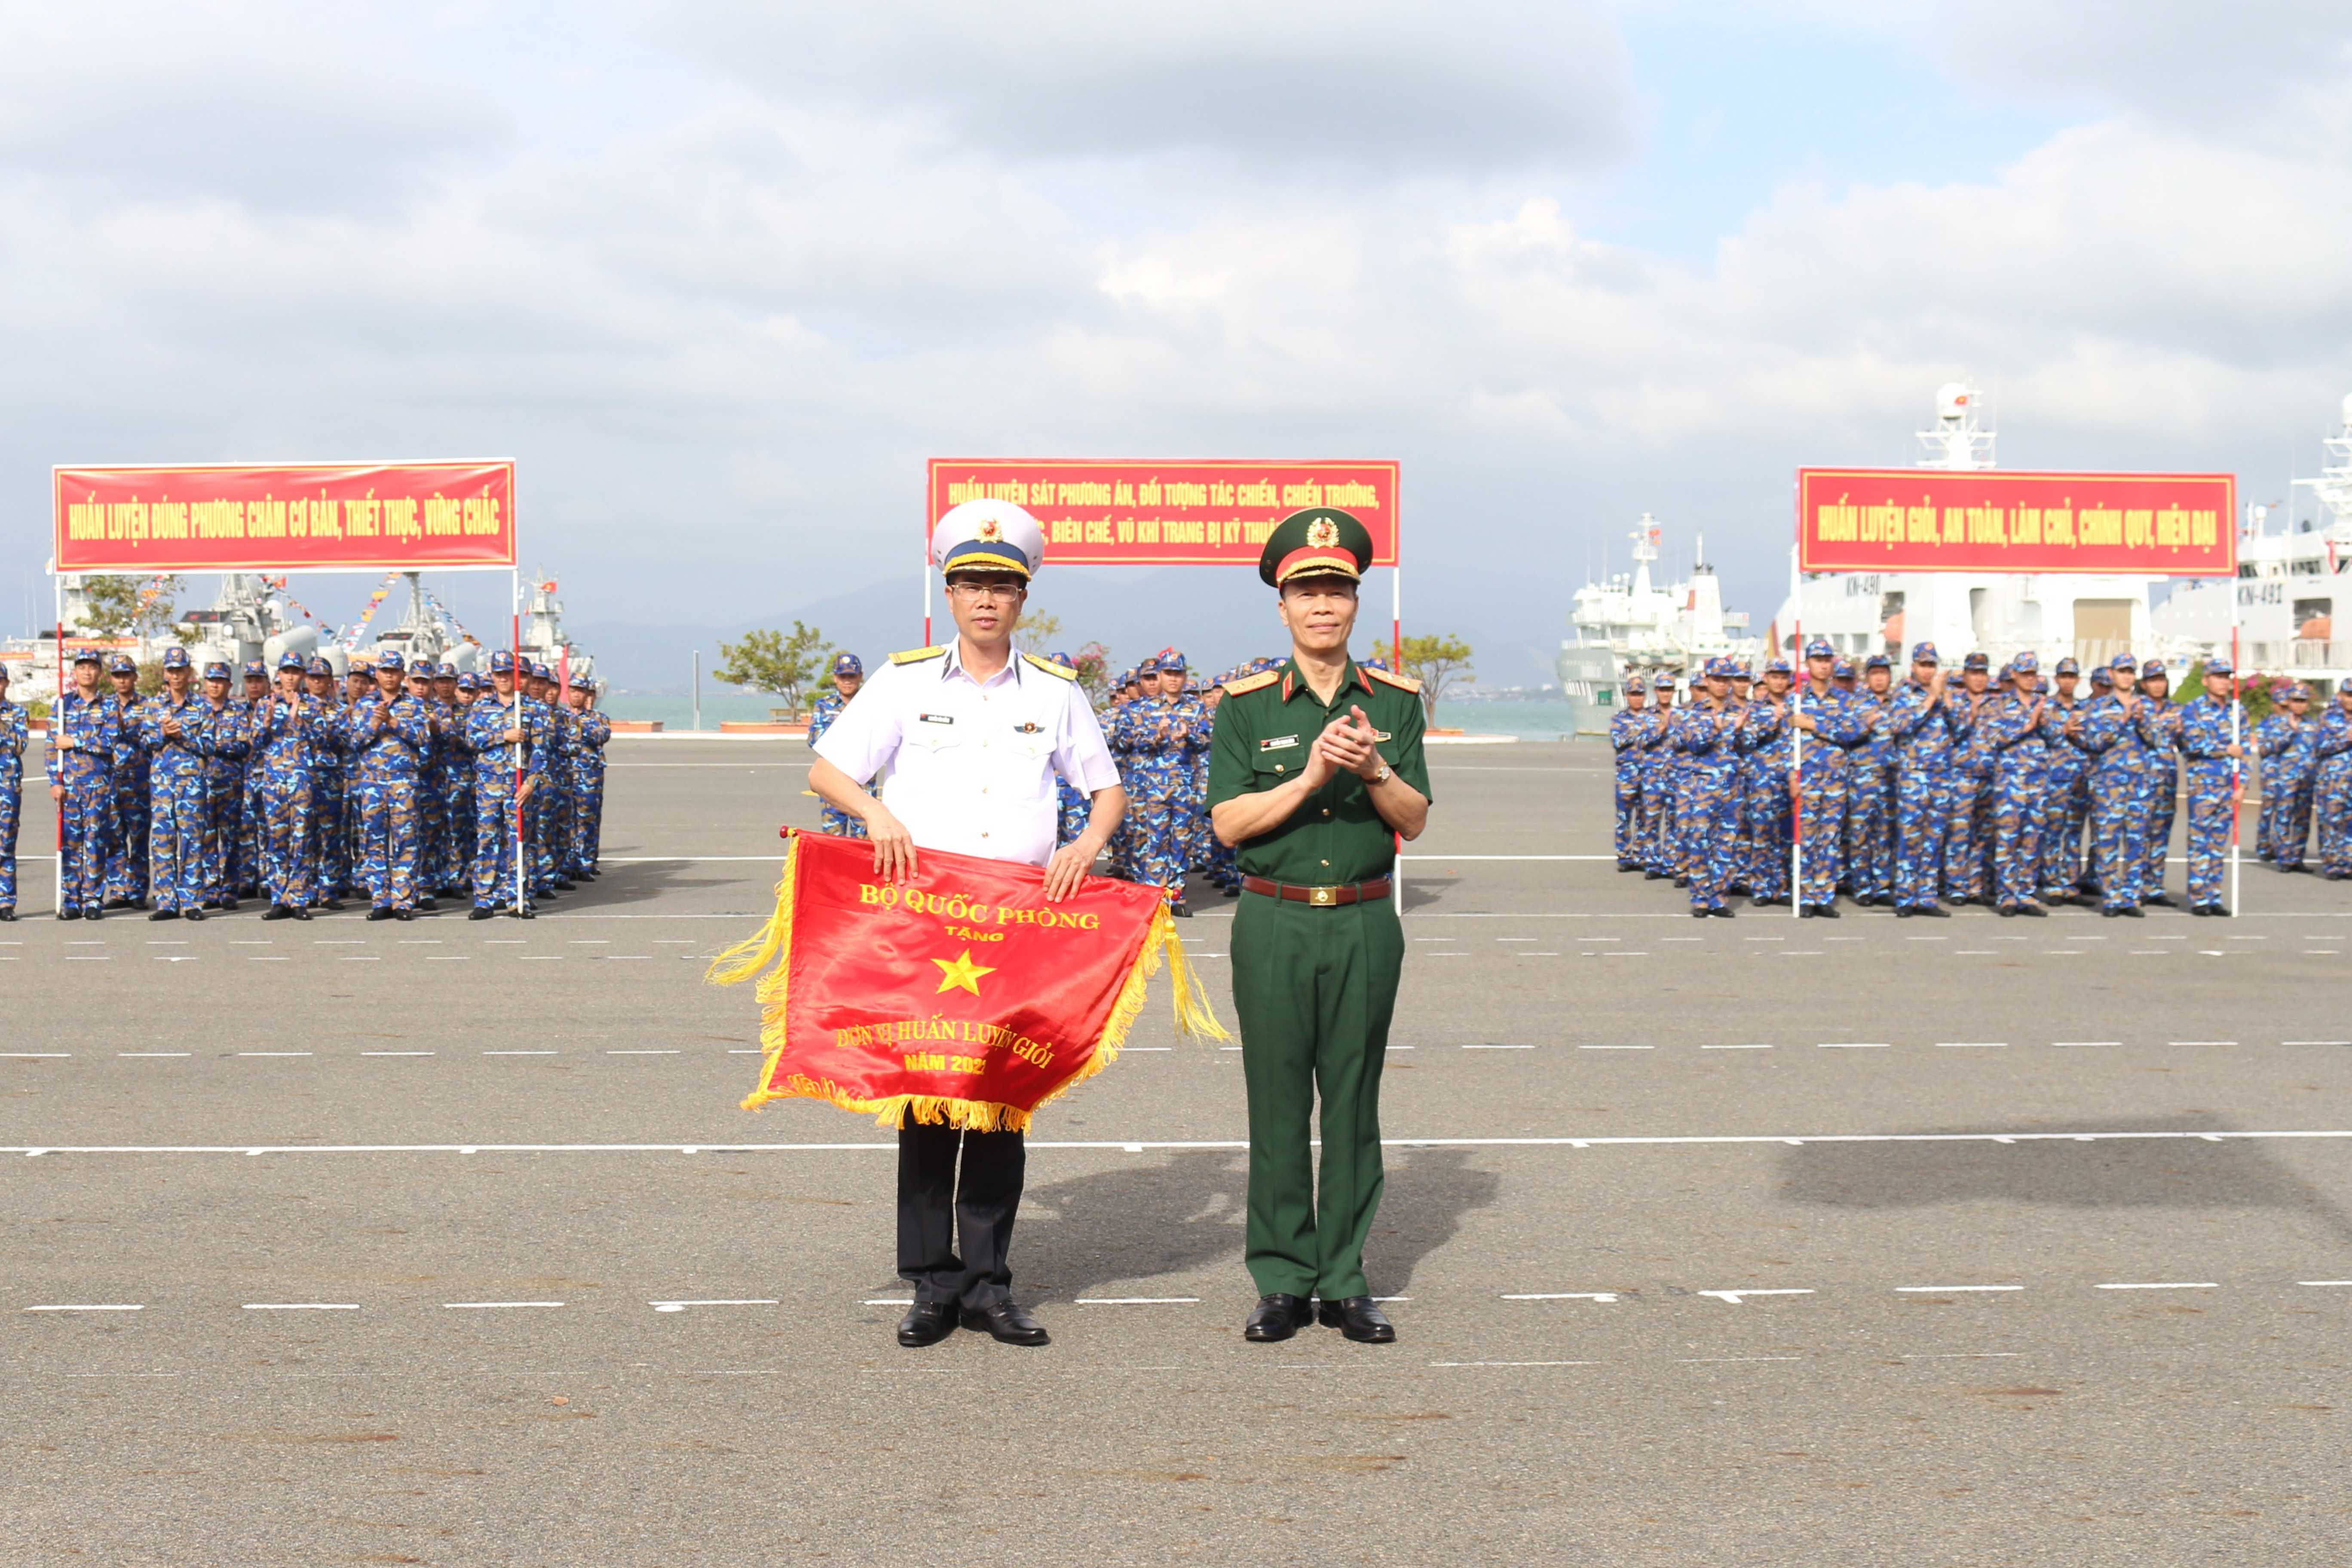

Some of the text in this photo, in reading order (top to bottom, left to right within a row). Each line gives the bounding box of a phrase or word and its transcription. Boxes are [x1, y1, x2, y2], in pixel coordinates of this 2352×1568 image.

[949, 475, 985, 505] HUẤN
[1031, 479, 1055, 506] SÁT
[1058, 481, 1111, 506] PHƯƠNG
[1114, 479, 1136, 508] ÁN,
[1139, 476, 1161, 506] ĐỐI
[1164, 482, 1207, 511] TƯỢNG
[1210, 480, 1234, 506] TÁC
[1237, 478, 1280, 509] CHIẾN,
[1283, 478, 1322, 510] CHIẾN
[1325, 480, 1380, 510] TRƯỜNG,
[69, 485, 500, 547] HUẤN LUYỆN ĐÚNG PHƯƠNG CHÂM CƠ BẢN, THIẾT THỰC, VỮNG CHẮC
[1052, 516, 1082, 543] BIÊN
[1085, 514, 1114, 545] CHẾ,
[1117, 517, 1135, 543] VŨ
[1137, 517, 1160, 543] KHÍ
[1162, 521, 1204, 543] TRANG
[1207, 521, 1221, 548] BỊ
[1224, 517, 1241, 544] KỸ
[1818, 493, 2217, 554] HUẤN LUYỆN GIỎI, AN TOÀN, LÀM CHỦ, CHÍNH QUY, HIỆN ĐẠI
[860, 882, 1101, 930] BỘ QUỐC PHÒNG
[945, 925, 1004, 942] TẶNG
[836, 1024, 873, 1047] ĐƠN
[898, 1013, 955, 1040] HUẤN
[1013, 1036, 1055, 1069] GIỎI
[904, 1051, 946, 1071] NĂM
